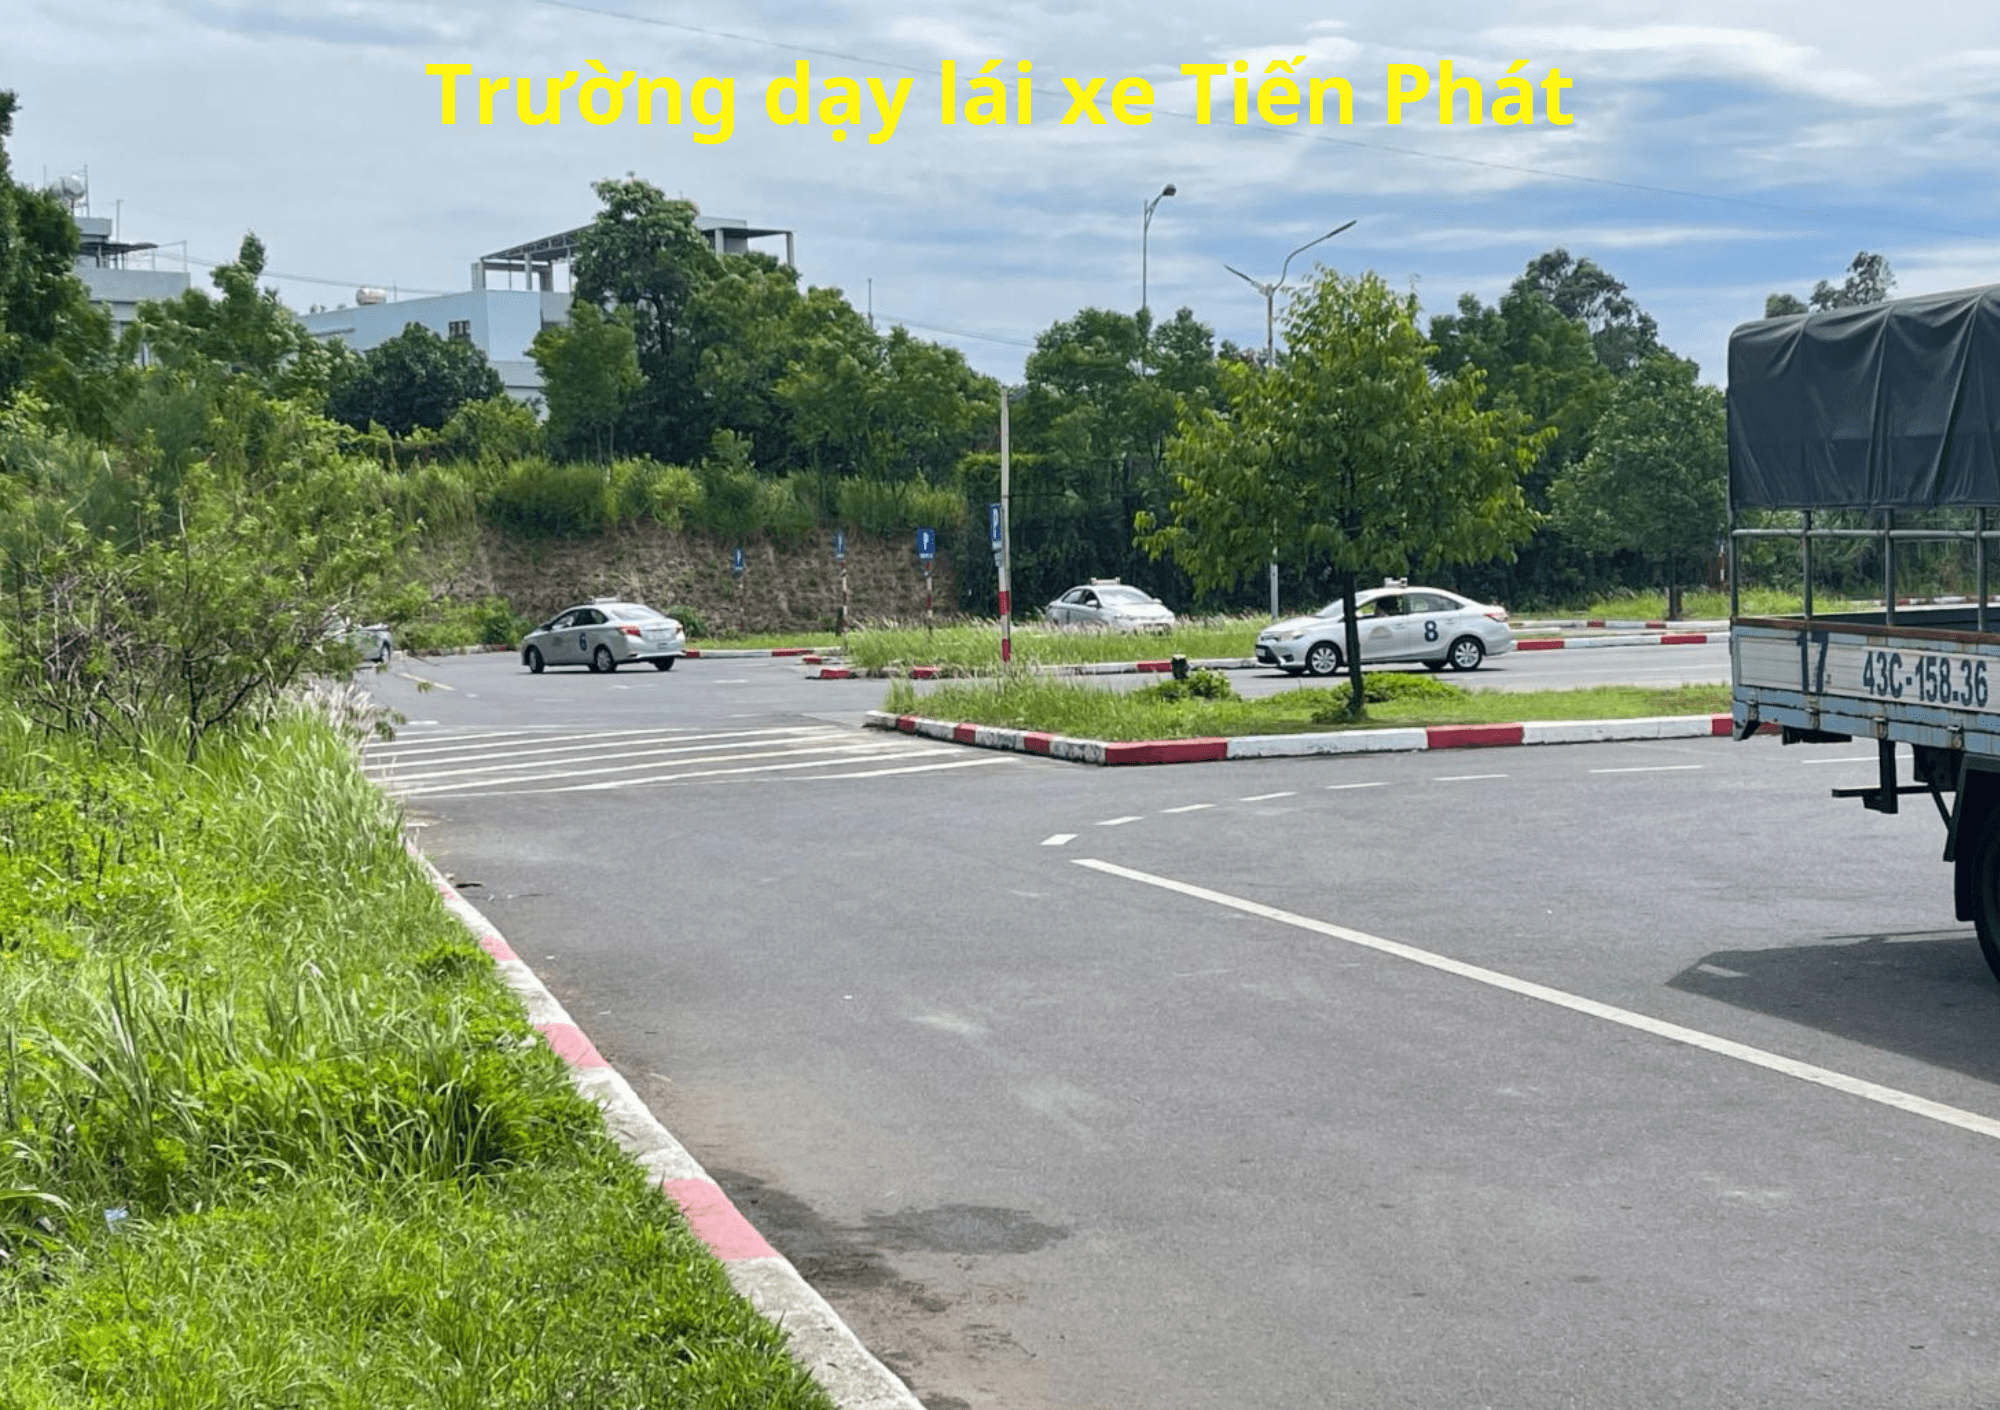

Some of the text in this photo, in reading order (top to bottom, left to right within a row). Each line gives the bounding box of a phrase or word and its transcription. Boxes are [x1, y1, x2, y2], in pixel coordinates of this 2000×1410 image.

[579, 632, 588, 651] 6
[1424, 620, 1439, 642] 8
[1796, 630, 1829, 694] 17
[1863, 651, 1988, 708] 43C-158.36
